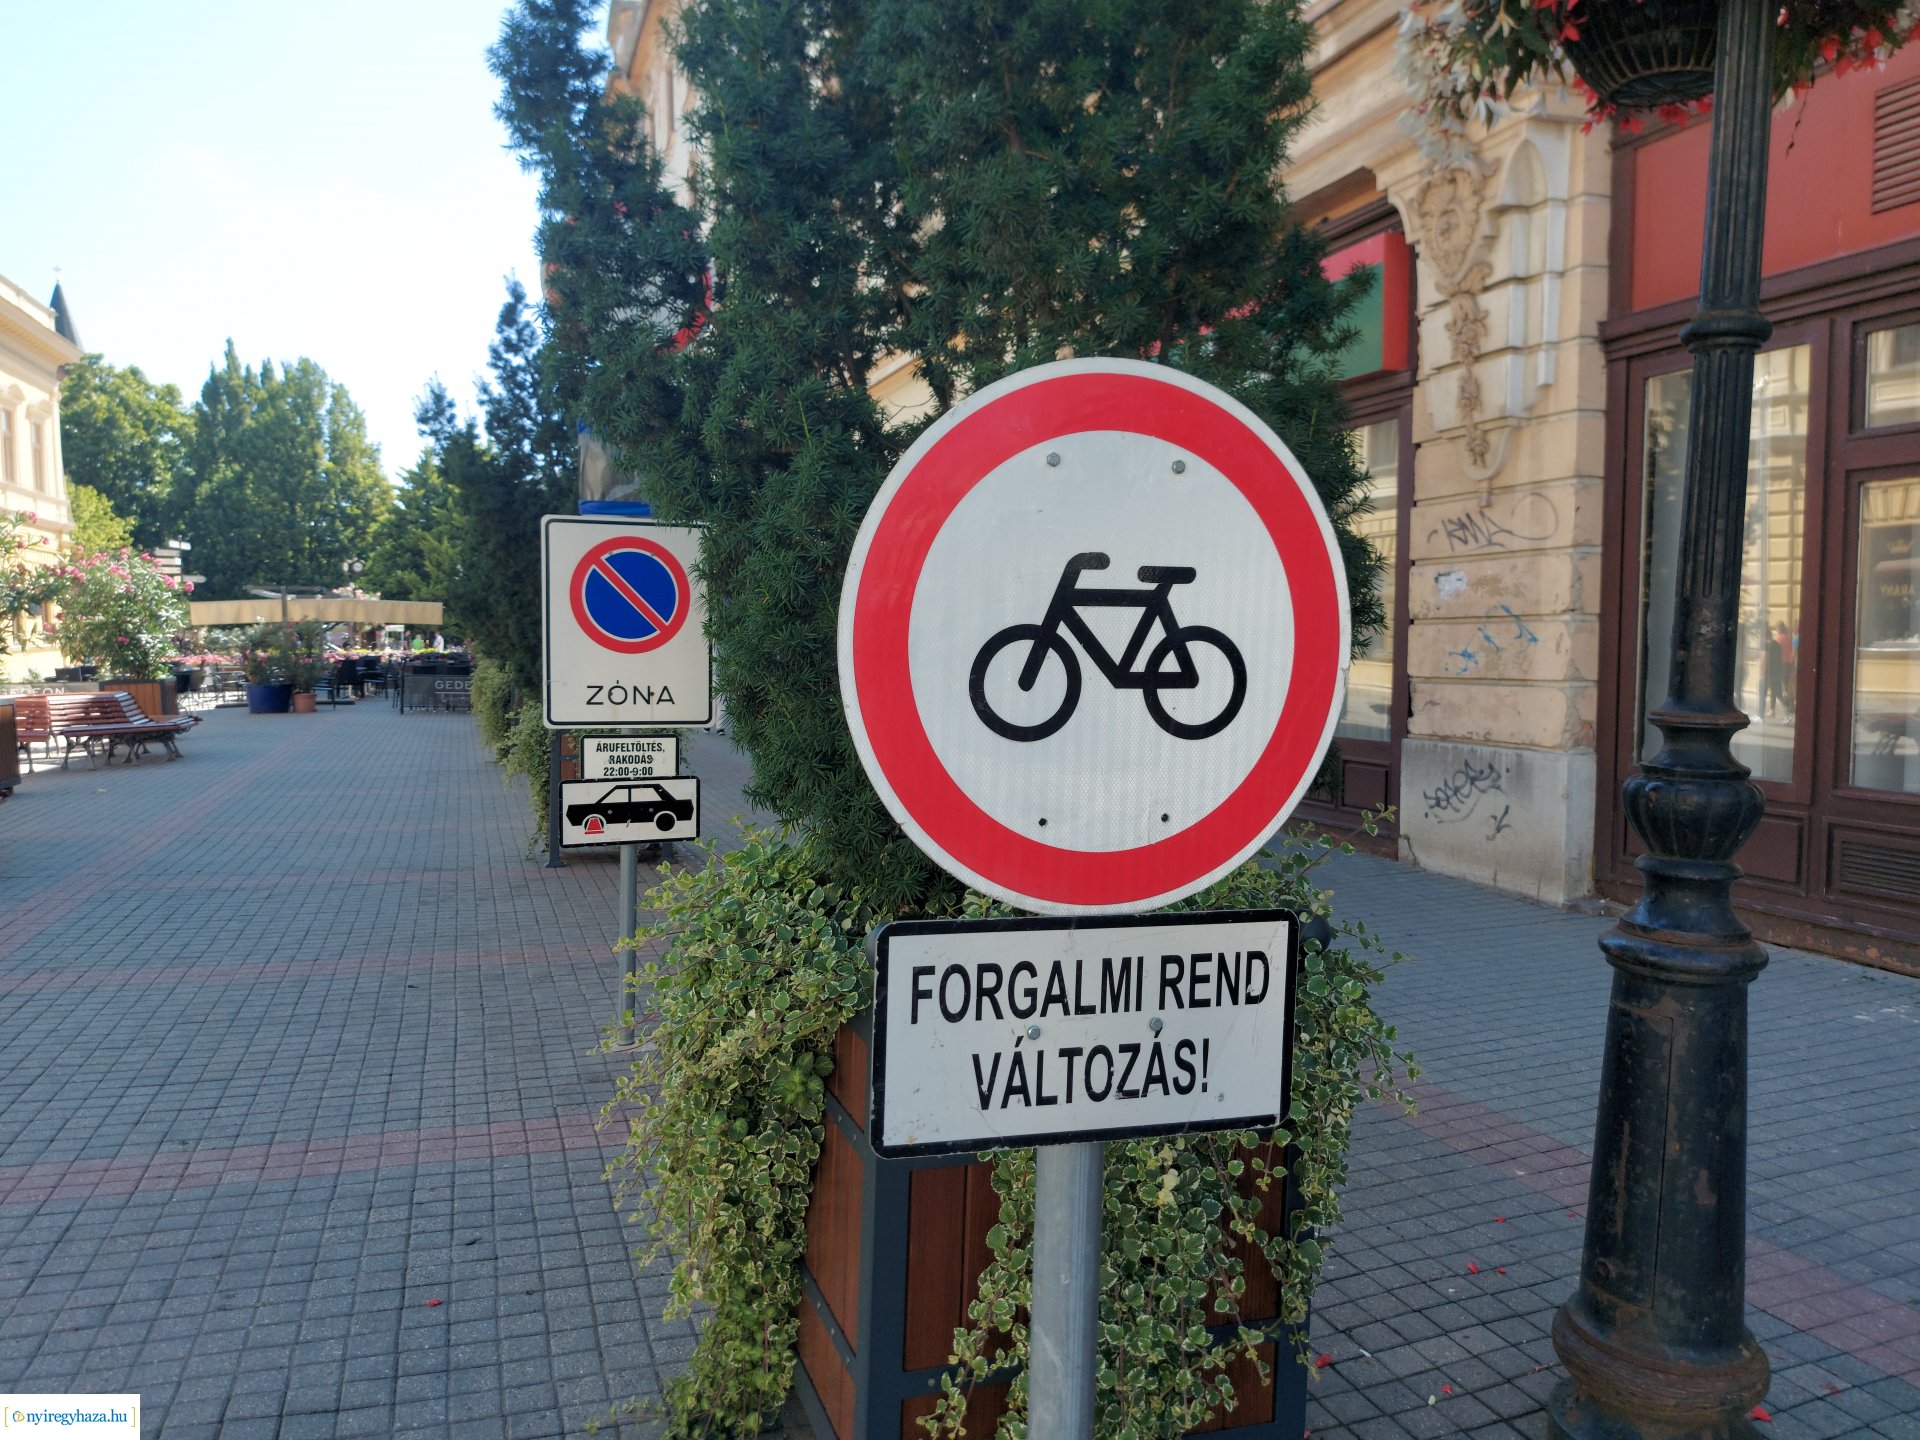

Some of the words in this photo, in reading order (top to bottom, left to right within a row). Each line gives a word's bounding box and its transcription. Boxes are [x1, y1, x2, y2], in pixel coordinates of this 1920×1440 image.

[586, 680, 676, 705] ZÓNA
[596, 741, 666, 753] ÁRUFELTÖLTÉS,
[608, 753, 654, 764] RAKODÁS
[603, 766, 653, 776] 22:00-9:00
[911, 955, 1144, 1025] FORGALMI
[1158, 950, 1271, 1011] REND
[971, 1028, 1210, 1111] VÁLTOZÁS!
